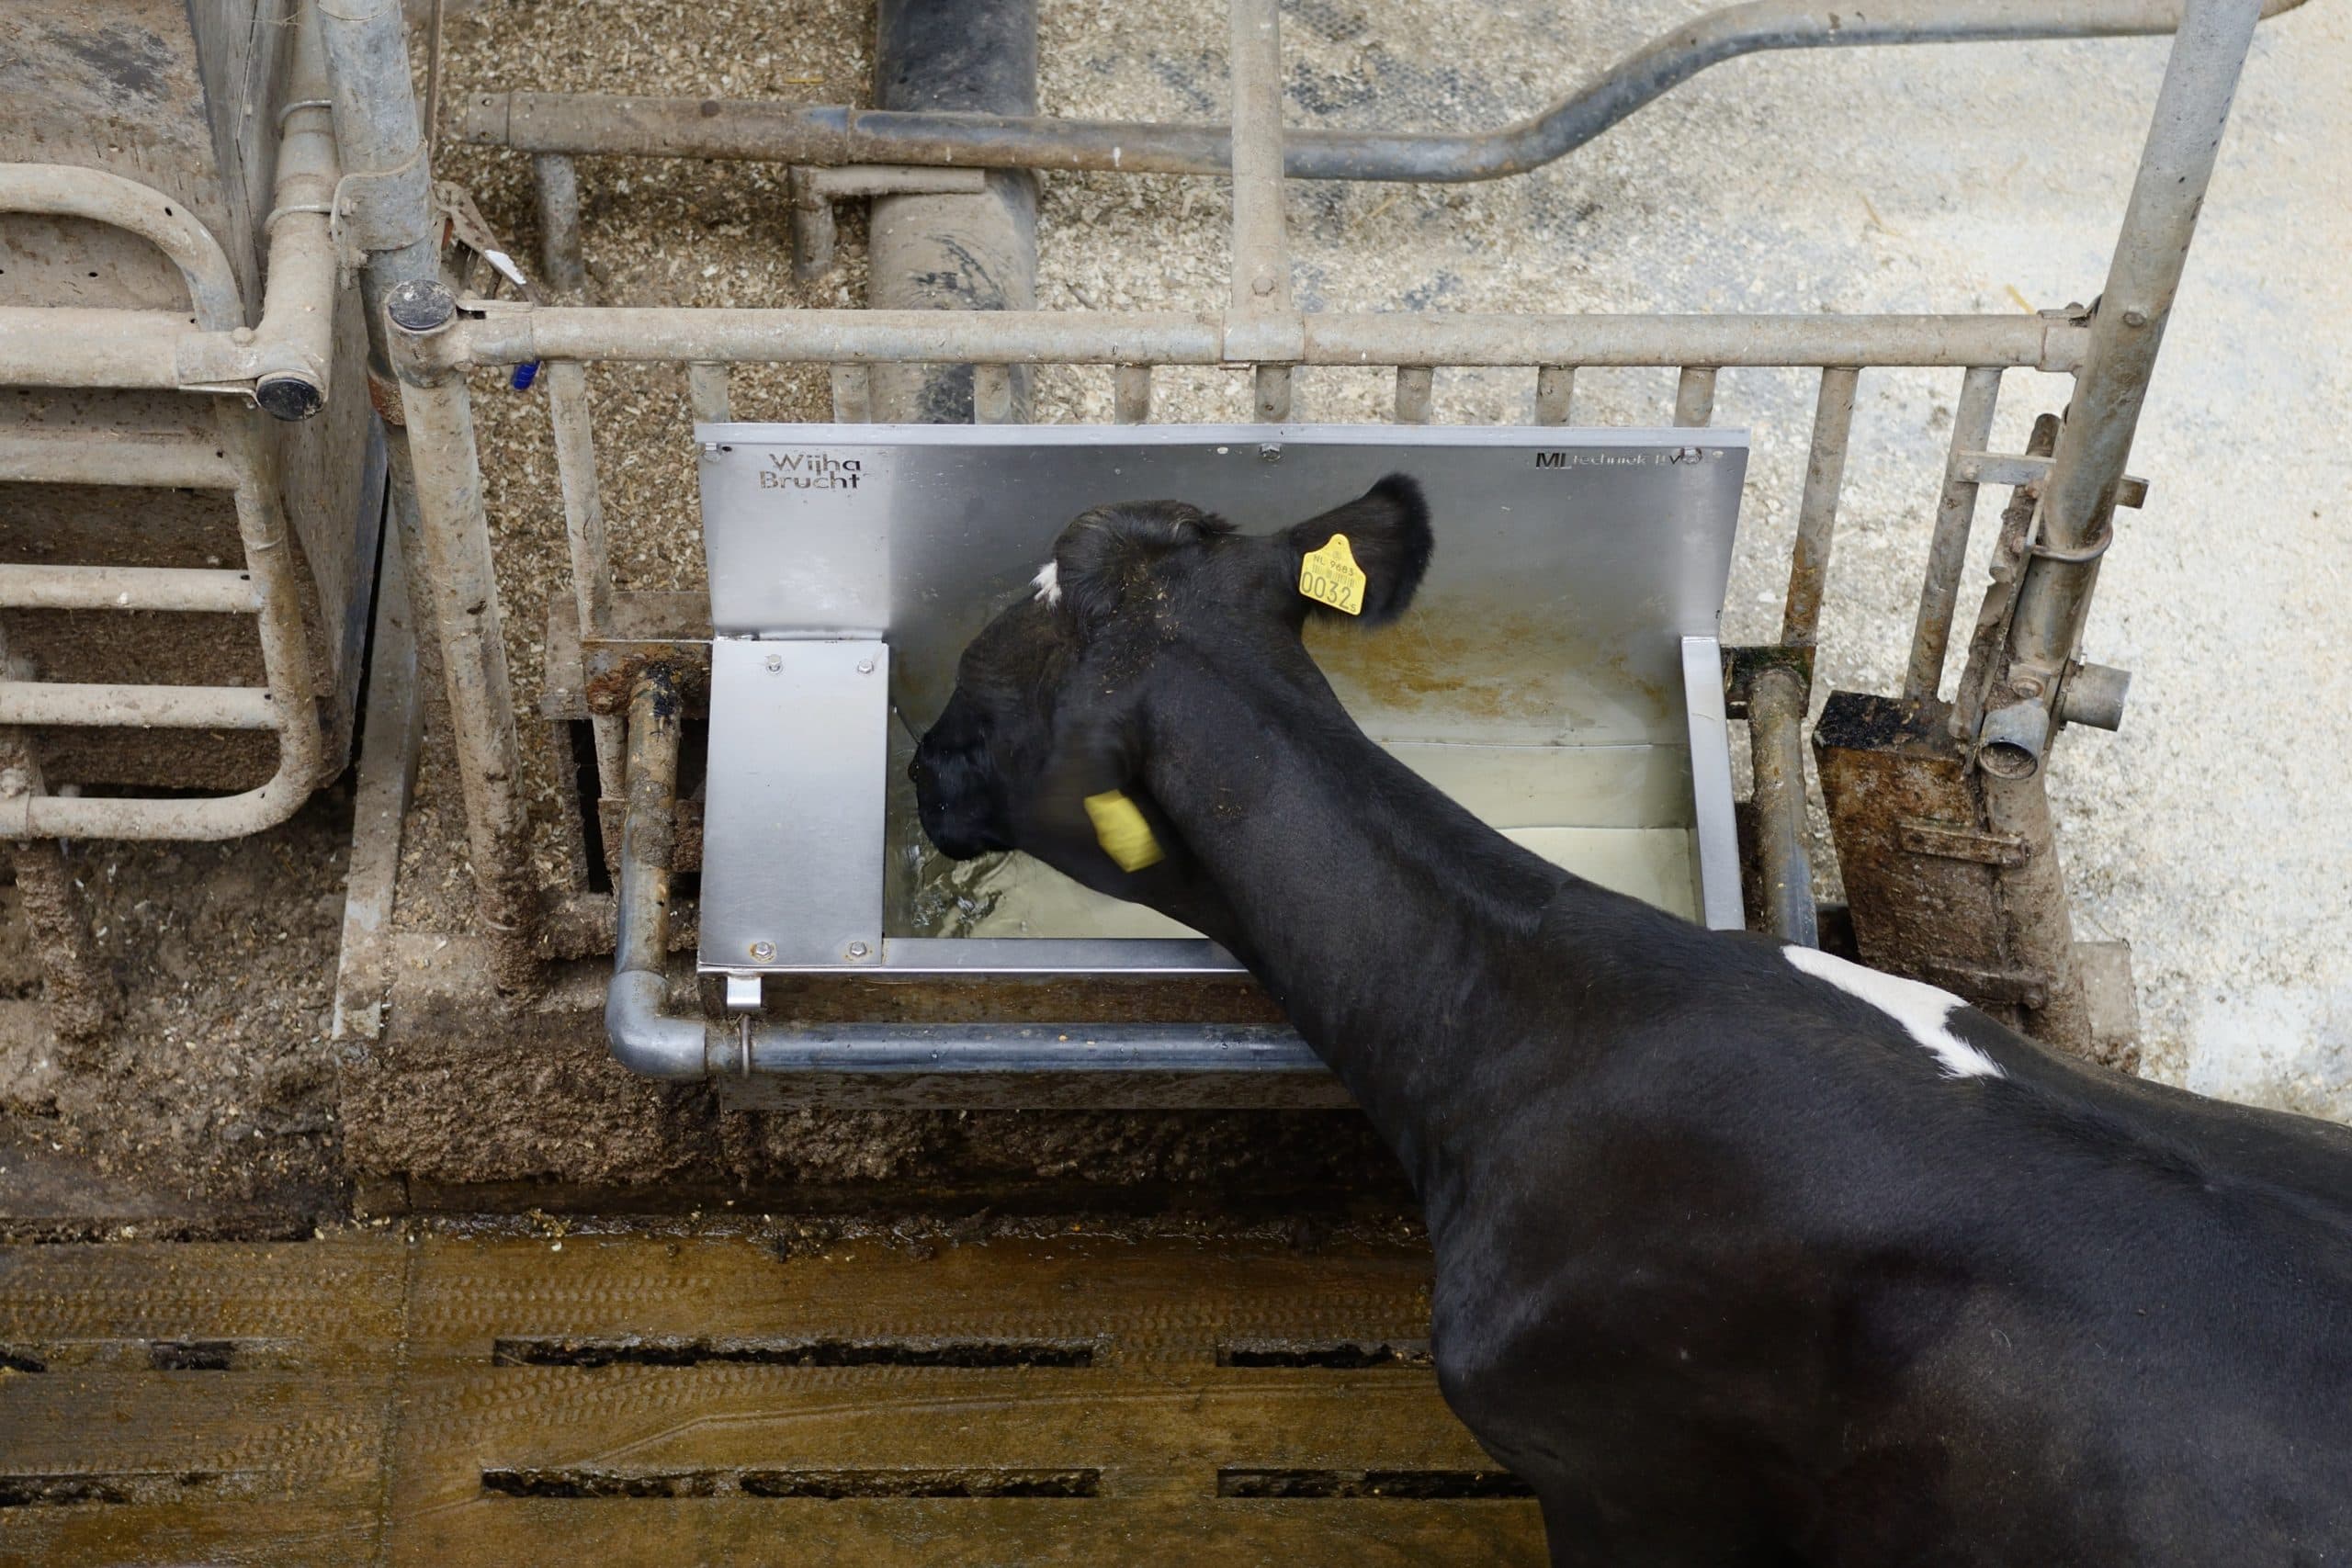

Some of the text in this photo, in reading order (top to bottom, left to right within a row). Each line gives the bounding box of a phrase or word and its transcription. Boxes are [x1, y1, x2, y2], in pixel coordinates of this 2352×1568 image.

[769, 454, 861, 476] Wijha
[1535, 452, 1572, 469] ML
[760, 470, 861, 489] Brucht
